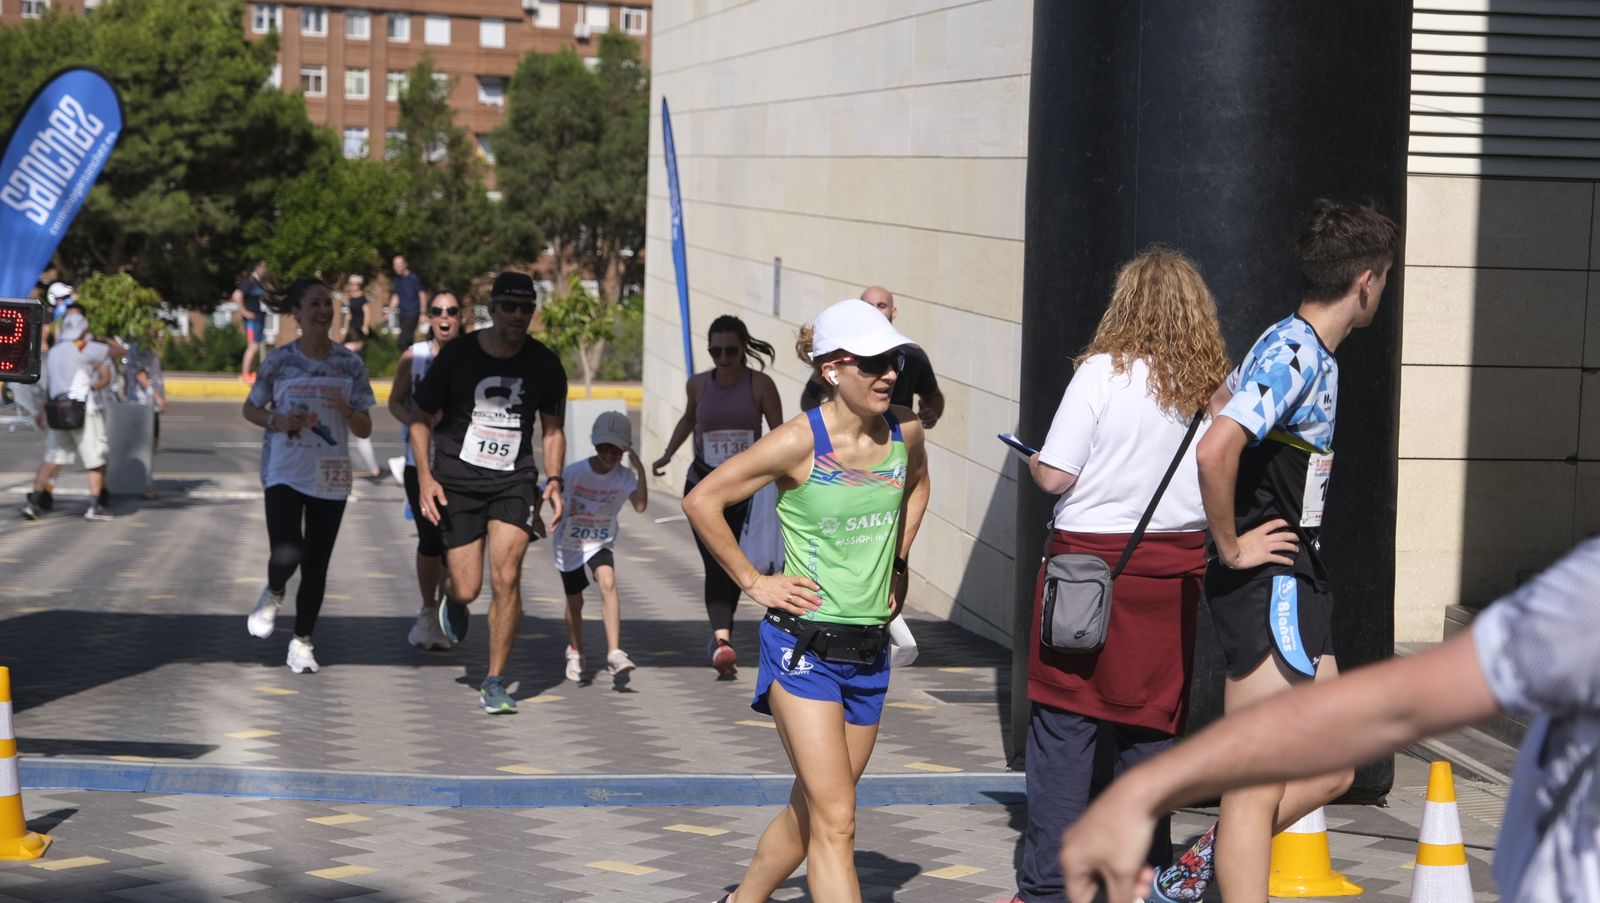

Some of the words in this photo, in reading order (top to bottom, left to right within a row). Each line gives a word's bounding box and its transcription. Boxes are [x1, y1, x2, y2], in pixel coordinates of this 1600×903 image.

[478, 440, 510, 456] 195
[570, 527, 609, 540] 2035
[1277, 601, 1292, 651] Blanes
